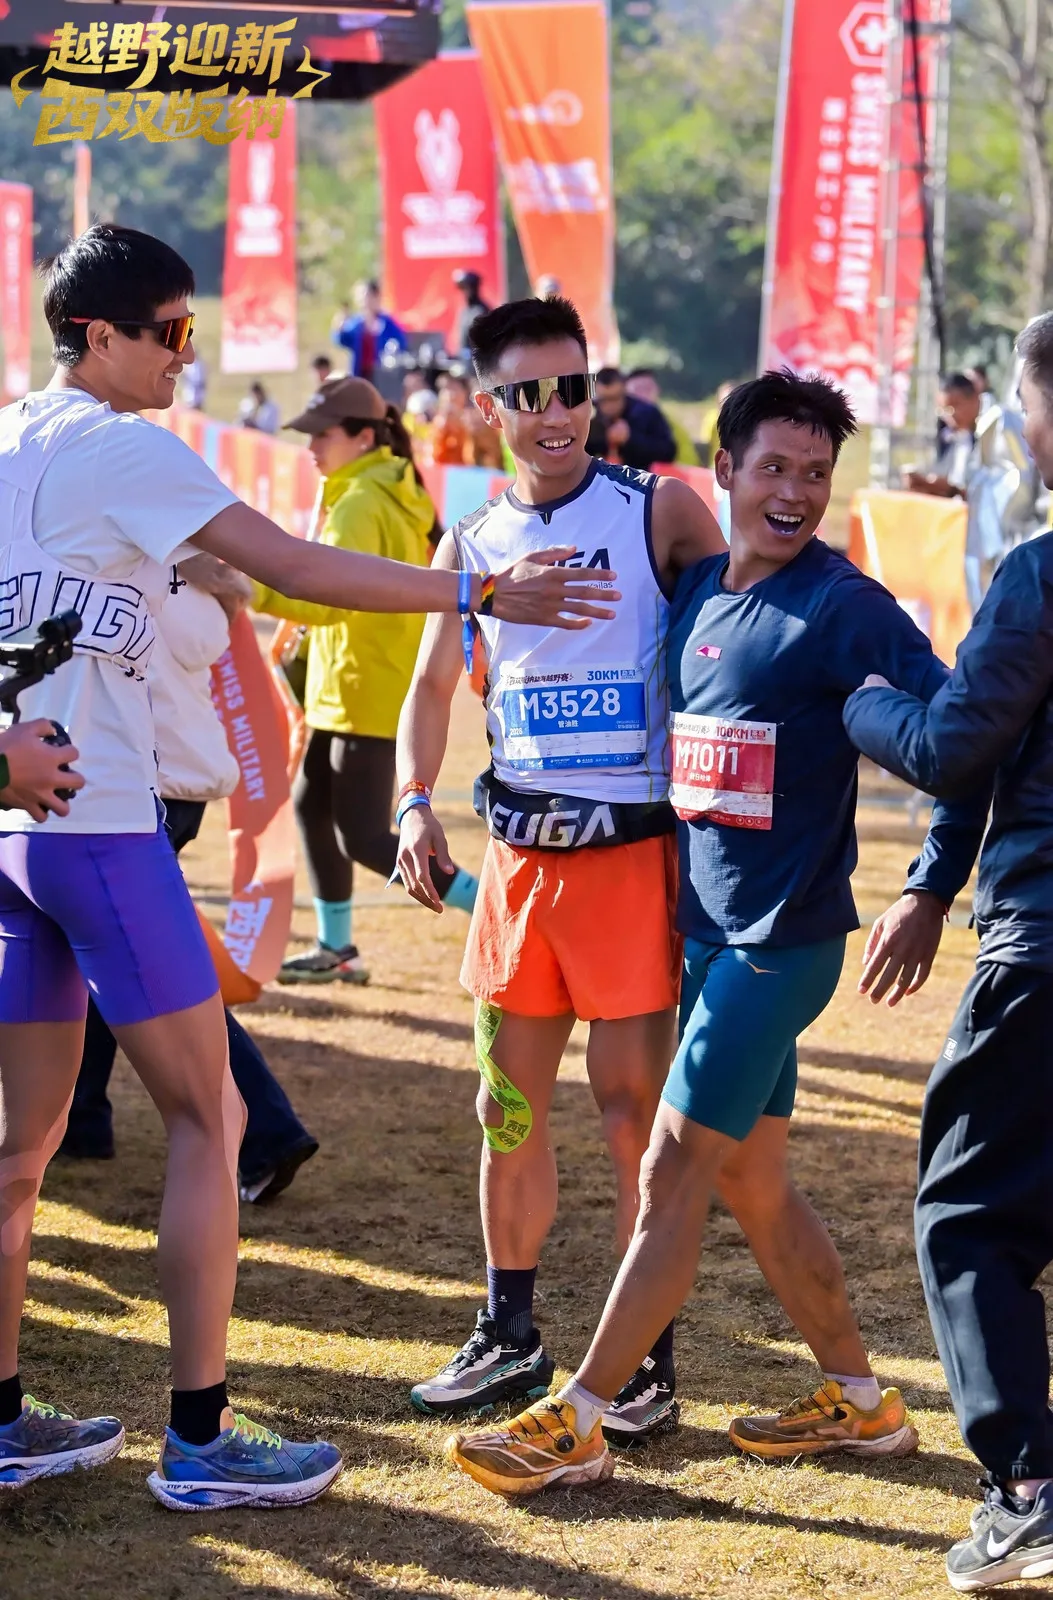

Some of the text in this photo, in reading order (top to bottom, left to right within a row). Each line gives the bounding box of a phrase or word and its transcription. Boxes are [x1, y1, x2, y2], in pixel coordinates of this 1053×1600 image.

[835, 72, 888, 314] SWISS MILITARY
[587, 670, 619, 682] 30KM
[518, 687, 621, 721] M3528
[716, 726, 749, 740] 100KM
[231, 714, 265, 801] MILITARY
[675, 740, 739, 775] M1011
